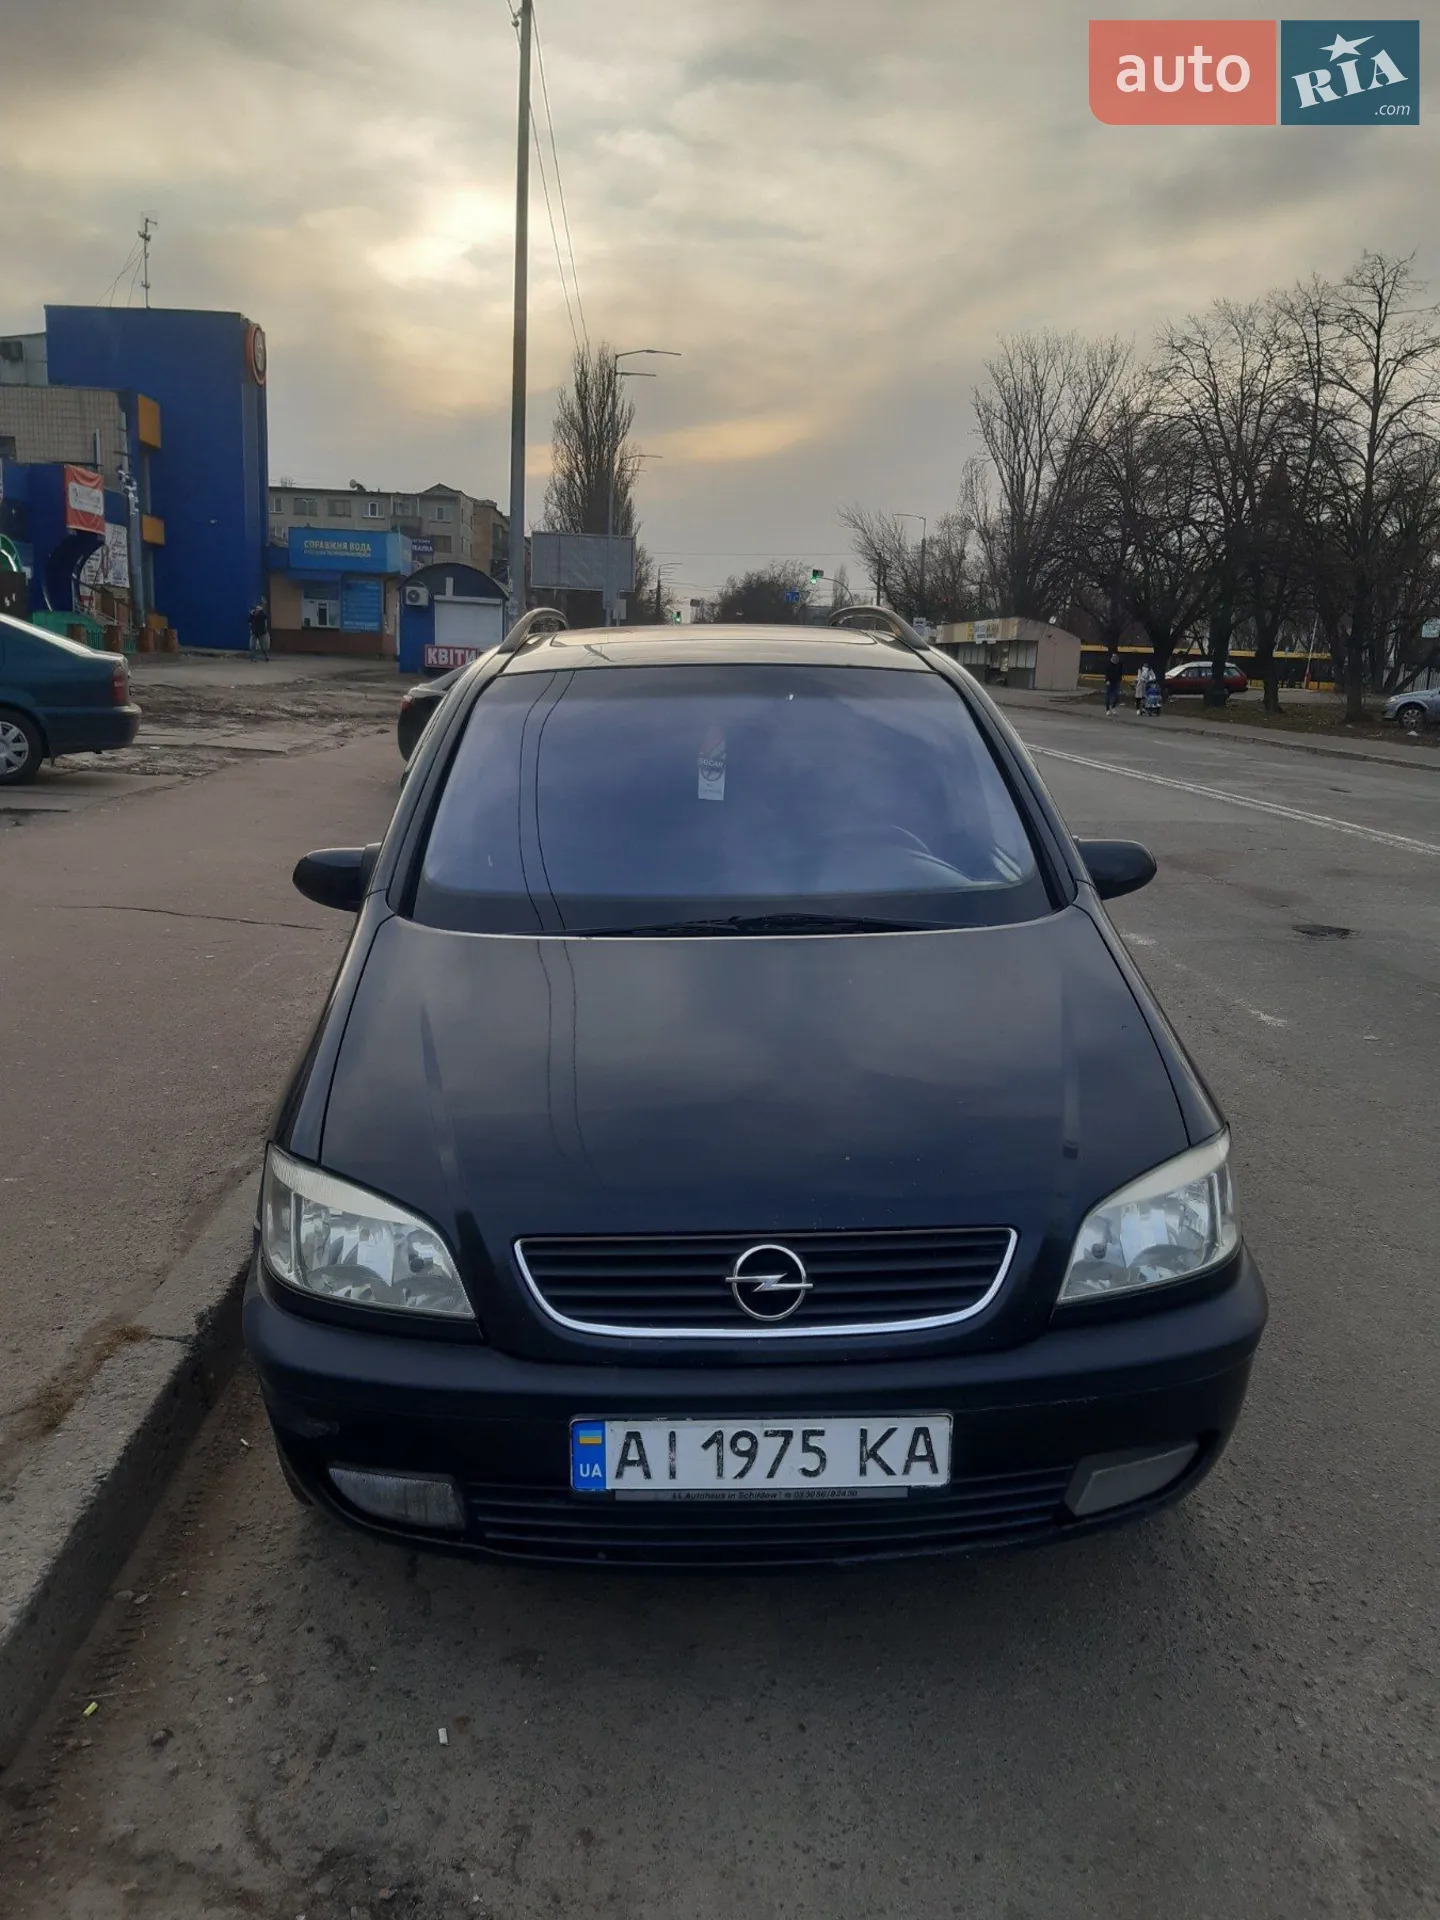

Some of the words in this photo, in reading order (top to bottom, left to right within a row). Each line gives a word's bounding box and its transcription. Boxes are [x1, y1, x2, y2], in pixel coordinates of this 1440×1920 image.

[303, 540, 348, 549] СПРАВЖНЯ
[349, 541, 371, 551] ВОДА
[427, 647, 477, 666] КВІТИ
[615, 1430, 677, 1480] AI
[700, 1429, 827, 1479] 1975
[858, 1426, 940, 1478] KA
[579, 1463, 603, 1478] UA
